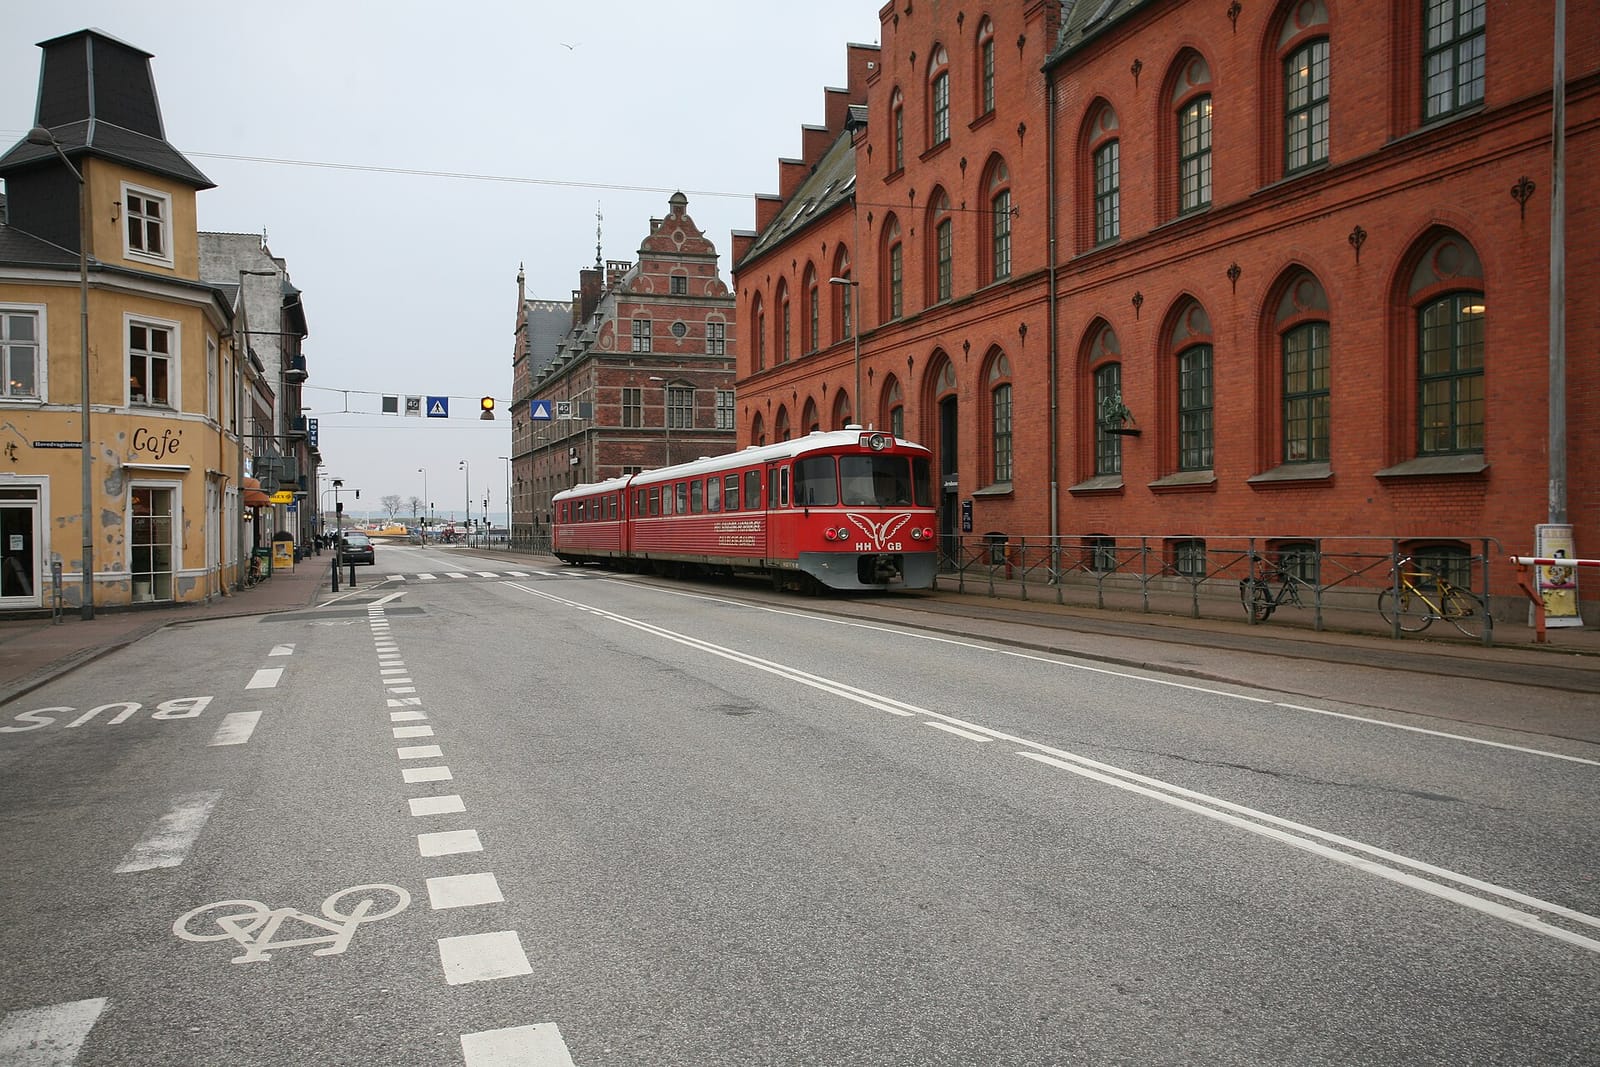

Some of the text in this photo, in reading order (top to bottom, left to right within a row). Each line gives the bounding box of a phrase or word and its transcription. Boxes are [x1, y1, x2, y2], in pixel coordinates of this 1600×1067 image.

[133, 428, 182, 460] Café
[855, 542, 902, 551] HH GB
[0, 696, 214, 733] BUS
